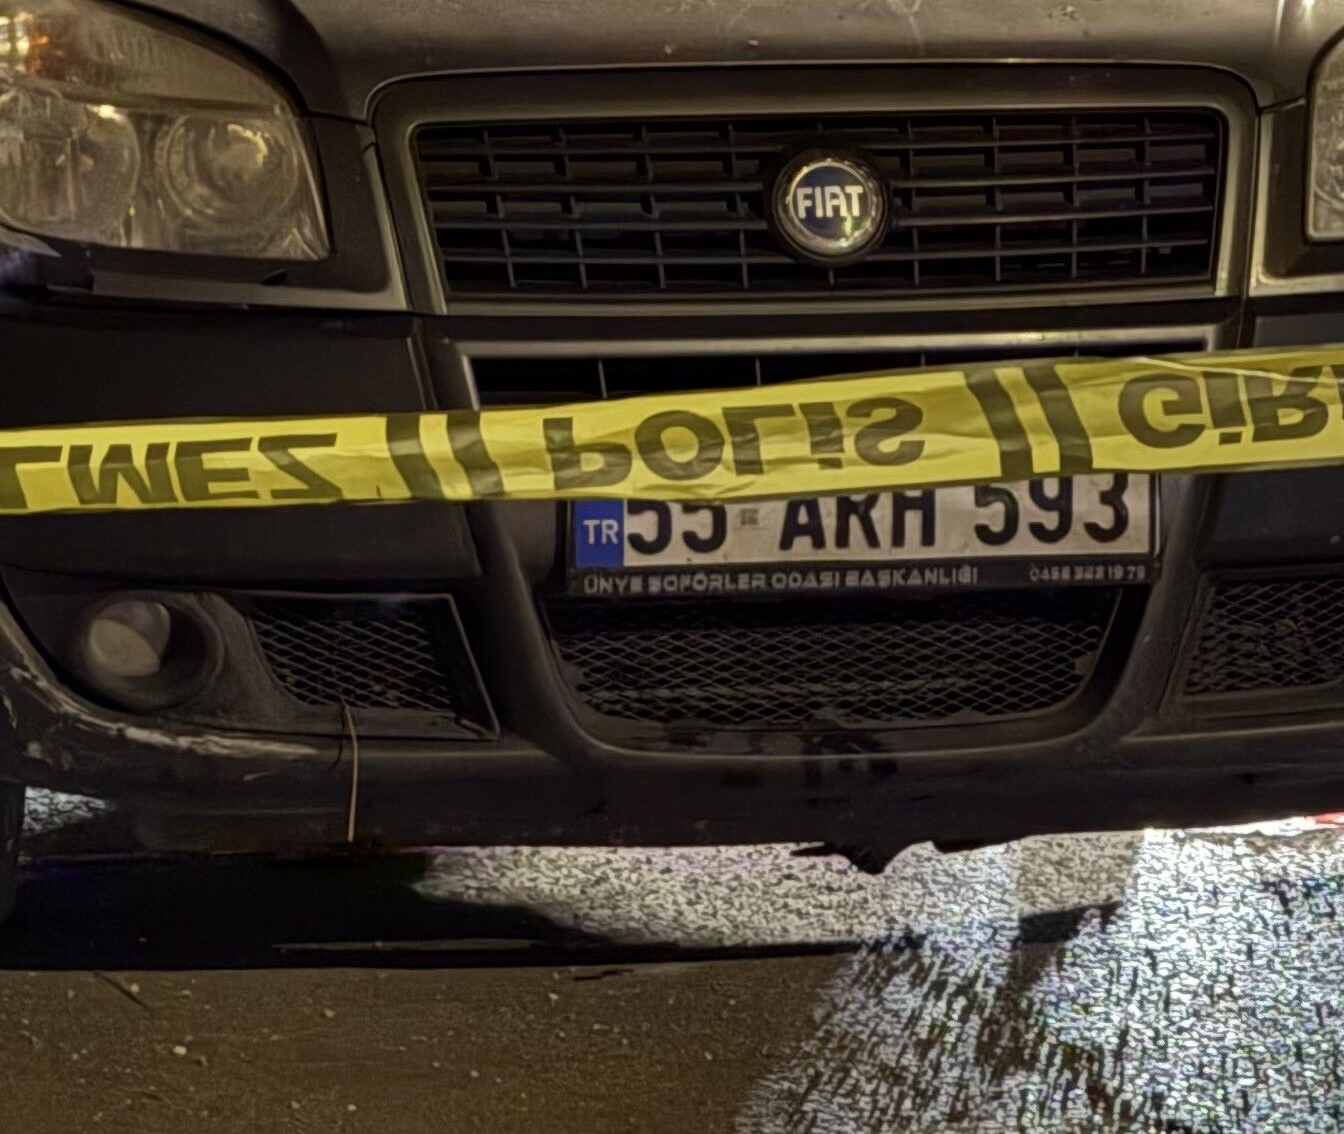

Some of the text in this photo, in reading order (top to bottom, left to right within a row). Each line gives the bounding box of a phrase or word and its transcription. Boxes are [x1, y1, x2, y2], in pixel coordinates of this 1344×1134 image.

[795, 184, 864, 219] FIAT
[778, 487, 937, 551] ARH
[973, 472, 1130, 547] 593
[582, 518, 619, 546] TR
